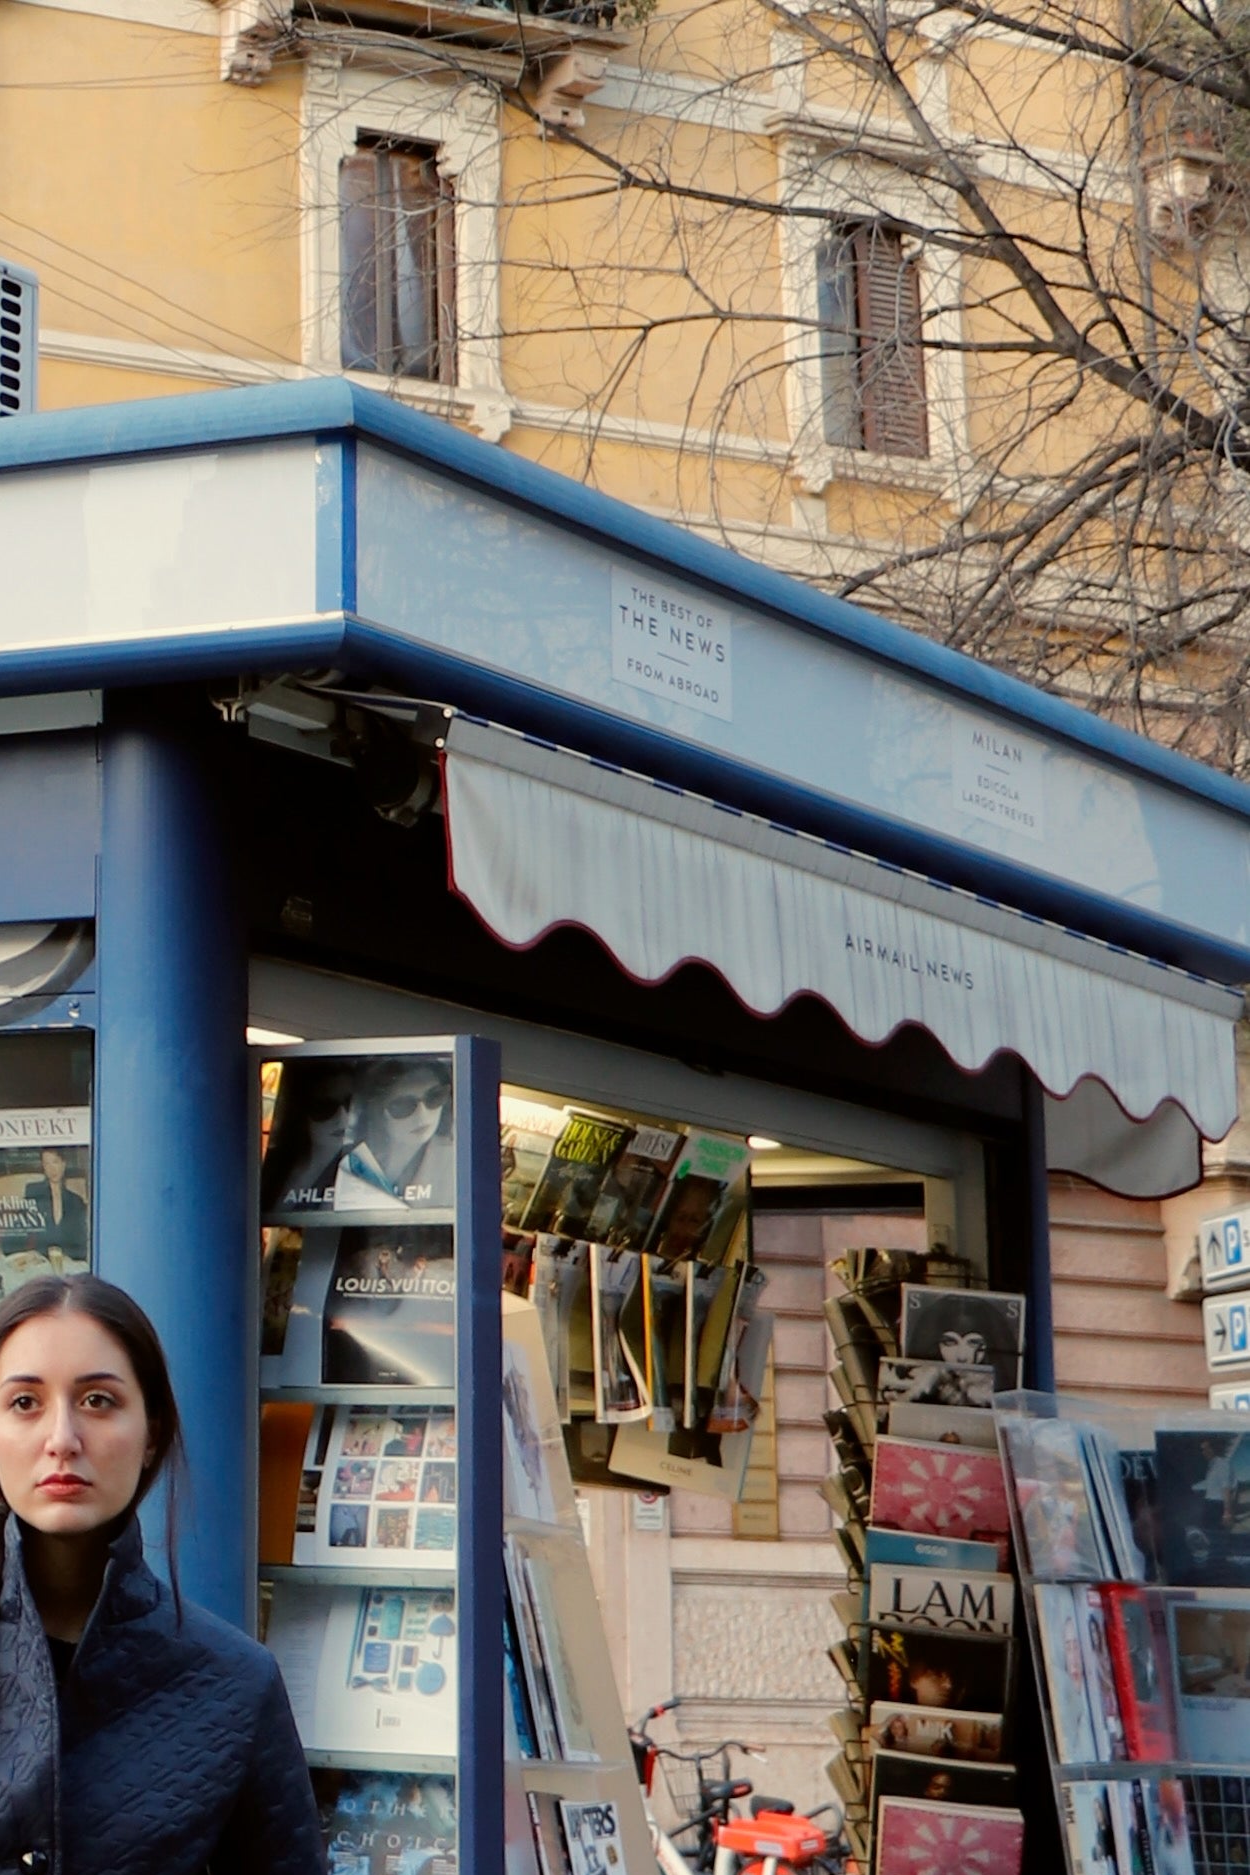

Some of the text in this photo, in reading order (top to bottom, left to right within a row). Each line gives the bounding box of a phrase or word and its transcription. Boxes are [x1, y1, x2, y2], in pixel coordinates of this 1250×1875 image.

[631, 587, 713, 629] THE BEST OF
[619, 605, 726, 663] THE NEWS
[627, 658, 720, 703] FROM ABROAD
[972, 731, 1022, 762] MILAN
[285, 1187, 335, 1204] AHLE
[335, 1277, 388, 1294] LOUIS
[891, 1576, 997, 1620] LAM
[336, 1830, 448, 1851] CHOIC
